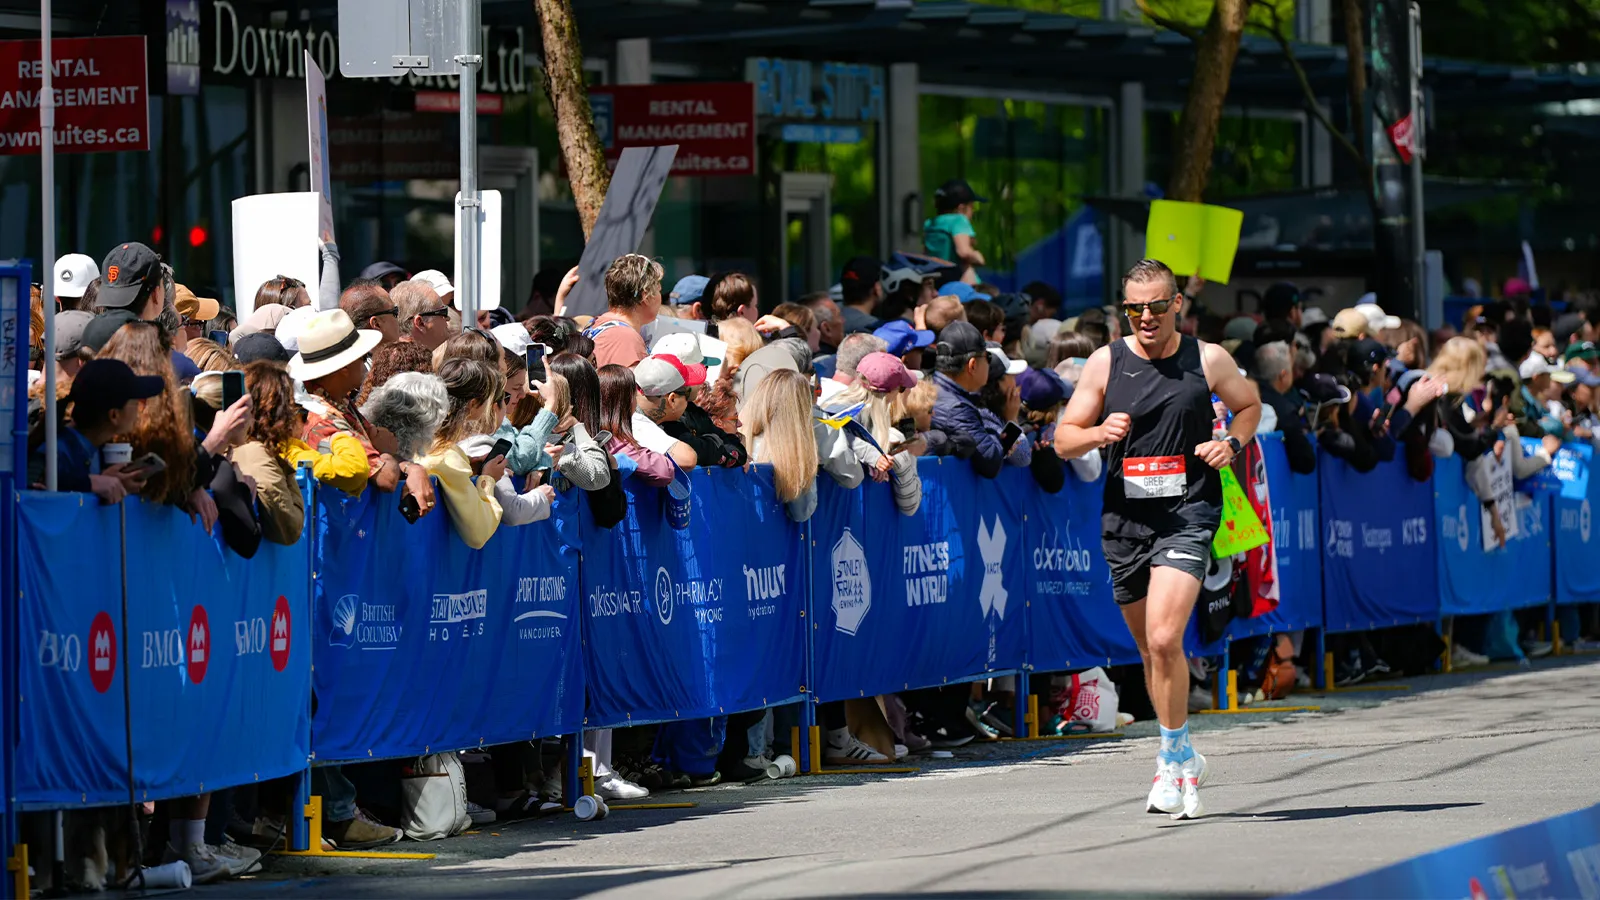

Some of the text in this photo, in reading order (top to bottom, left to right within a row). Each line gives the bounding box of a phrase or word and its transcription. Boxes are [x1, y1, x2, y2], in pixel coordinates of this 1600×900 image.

[212, 0, 337, 81] Downto
[18, 58, 101, 79] RENTAL
[0, 85, 140, 109] ANAGEMENT
[648, 99, 718, 117] RENTAL
[617, 121, 749, 142] MANAGEMENT
[1143, 475, 1165, 488] GREG
[903, 541, 949, 575] FITNESS
[539, 575, 567, 602] HOSTING
[905, 574, 947, 607] WORLD
[362, 602, 396, 622] BRITISH
[429, 622, 484, 641] HOES
[519, 626, 562, 640] VANCOUVER
[140, 629, 183, 668] BMO
